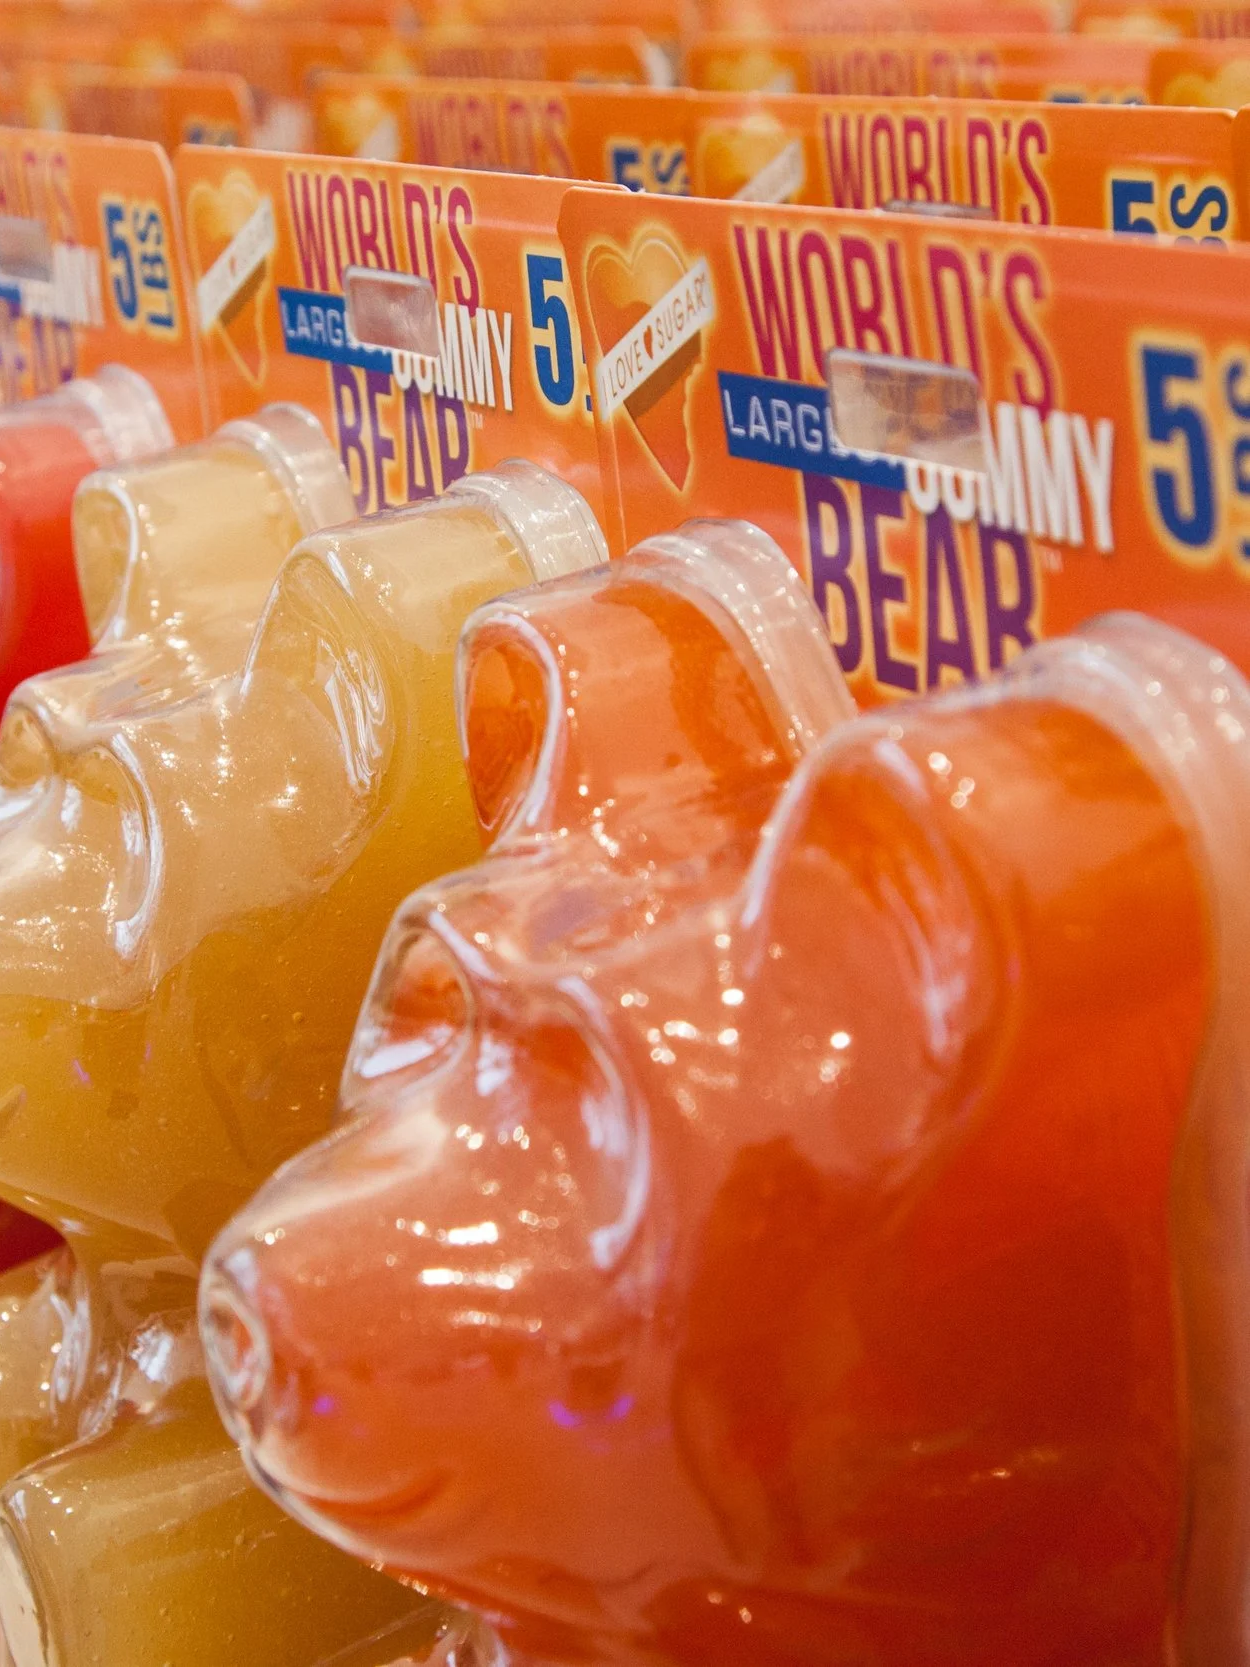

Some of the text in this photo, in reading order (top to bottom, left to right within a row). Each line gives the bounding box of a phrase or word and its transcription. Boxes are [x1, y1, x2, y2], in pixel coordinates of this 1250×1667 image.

[105, 204, 137, 319] 5
[288, 171, 479, 318] WORLD'S
[281, 300, 388, 355] LARG
[526, 253, 574, 406] 5
[609, 339, 644, 398] LOVE
[655, 274, 707, 350] SUGAR
[732, 225, 1053, 421] WORLD'S
[723, 389, 900, 468] LARG
[1142, 344, 1216, 547] 5
[802, 470, 1037, 693] BEAR
